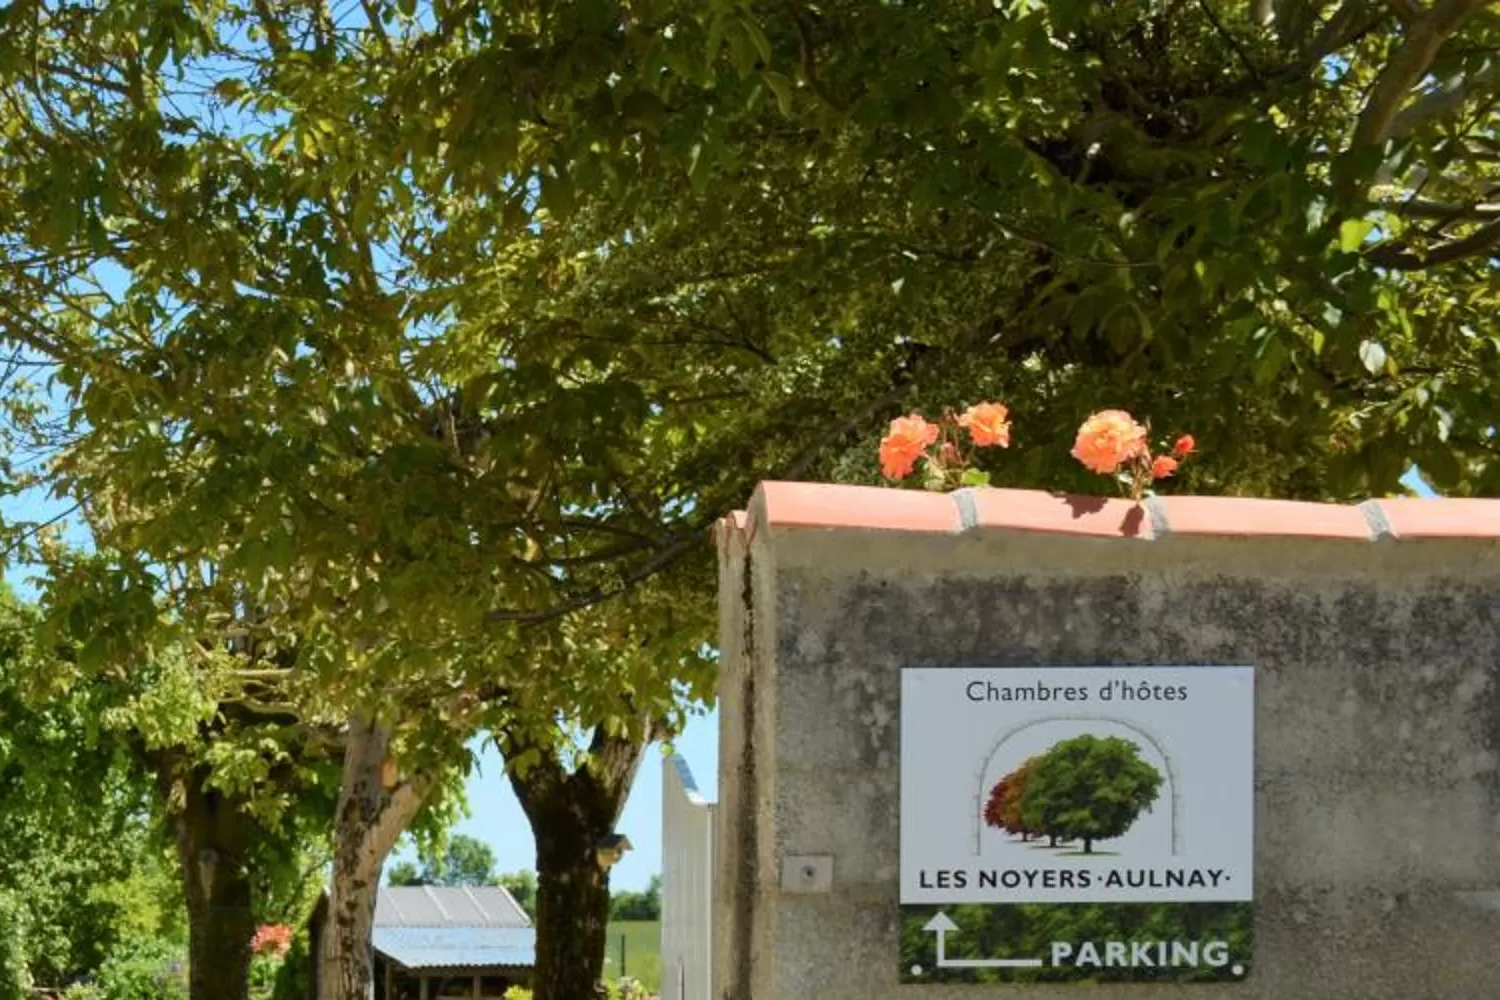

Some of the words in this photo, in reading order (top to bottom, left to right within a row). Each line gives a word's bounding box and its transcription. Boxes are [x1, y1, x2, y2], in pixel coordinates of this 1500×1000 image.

[966, 679, 1088, 702] Chambres
[1099, 679, 1188, 702] d'hôtes
[919, 868, 967, 889] LES
[1051, 941, 1228, 968] PARKING
